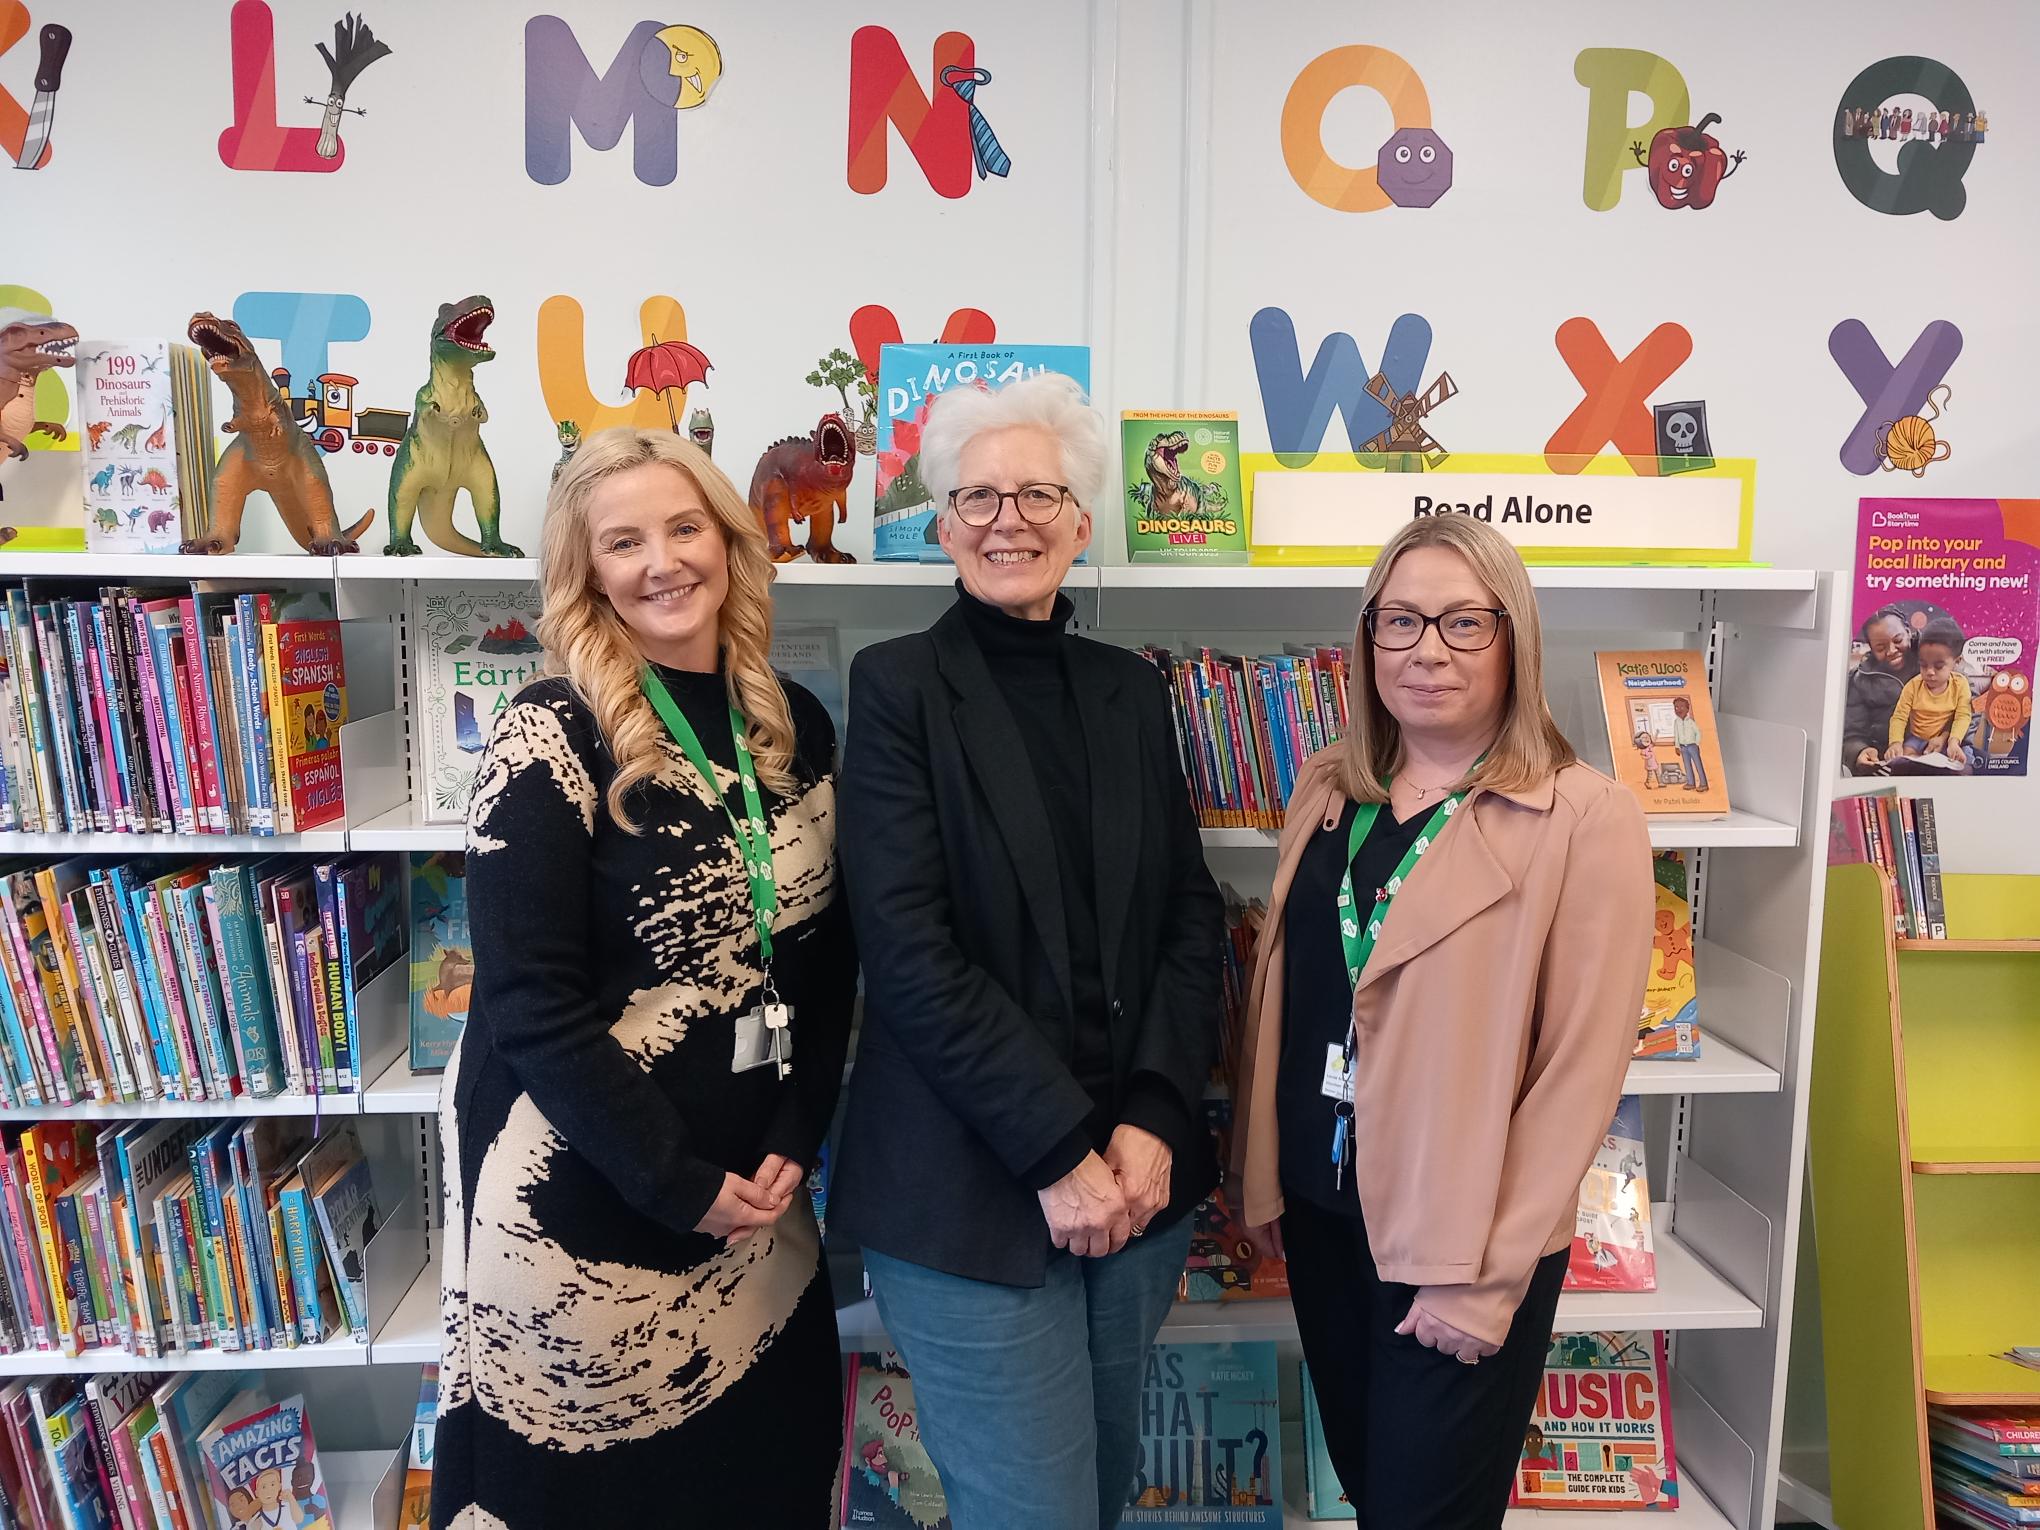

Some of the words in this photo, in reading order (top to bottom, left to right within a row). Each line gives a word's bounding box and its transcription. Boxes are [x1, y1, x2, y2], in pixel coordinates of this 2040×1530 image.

[218, 0, 346, 172] L
[525, 15, 678, 187] M
[847, 25, 974, 199] N
[1281, 45, 1431, 213] O
[1574, 47, 1690, 212] P
[1833, 56, 1976, 221] Q
[106, 356, 135, 375] 199
[538, 295, 688, 432] U
[96, 378, 151, 391] Dinosaurs
[888, 360, 1048, 417] DINOSAU
[1249, 307, 1432, 469] W
[1544, 317, 1693, 475] X
[1828, 319, 1963, 475] Y
[100, 396, 144, 406] Prehistoric
[107, 407, 142, 417] Animals
[1414, 495, 1493, 524] Read
[1501, 495, 1592, 524] Alone
[1887, 512, 1919, 520] BookTrust
[1137, 520, 1236, 535] DINOSAURS
[1887, 520, 1919, 528] Storytime
[1172, 534, 1204, 543] LIVE!
[1869, 535, 1903, 553] Pop
[1907, 536, 1940, 550] into
[1944, 538, 1982, 554] your
[1159, 548, 1173, 556] UK
[1174, 548, 1197, 556] TOUR
[1867, 554, 1909, 569] local
[1912, 554, 1969, 573] library
[1972, 555, 2006, 569] and
[1866, 574, 1892, 591] try
[1895, 573, 1986, 592] something
[1989, 574, 2028, 588] new!
[184, 615, 193, 635] 100
[294, 632, 310, 642] First
[311, 632, 325, 641] Words
[106, 625, 116, 654] CENTURY
[112, 655, 120, 680] fashion
[116, 687, 125, 699] The
[188, 637, 199, 670] Favourite
[246, 647, 255, 671] Ready
[292, 664, 334, 685] SPANISH
[1617, 663, 1649, 676] Katie
[1651, 661, 1688, 674] Woo's
[193, 672, 204, 703] Nursery
[250, 678, 259, 704] School
[1628, 679, 1682, 687] Neighbourhood
[198, 705, 208, 734] Rhymes
[253, 705, 262, 729] Words
[296, 752, 319, 766] Primeras
[304, 763, 340, 786] ESPAÑOL
[95, 887, 110, 929] EYEWITNESS
[110, 942, 120, 968] GUIDES
[341, 931, 347, 941] My
[1934, 925, 1944, 935] P
[117, 972, 129, 1001] INSECT
[230, 962, 261, 1023] Animals
[328, 960, 344, 1010] HUMAN
[219, 964, 226, 972] IN
[230, 1009, 239, 1032] Frogs
[332, 1011, 347, 1052] BODY!
[246, 1047, 265, 1062] DK
[1, 1163, 11, 1187] DANCE
[29, 1162, 40, 1191] WORLD
[135, 1160, 144, 1193] THE
[35, 1193, 43, 1204] OF
[38, 1204, 48, 1229] SPORT
[289, 1206, 300, 1243] HARRY
[74, 1268, 87, 1299] TERRIFIC
[80, 1300, 91, 1324] TEAMS
[1144, 1353, 1184, 1388] AS
[1211, 1370, 1230, 1382] KATIE
[1230, 1370, 1254, 1382] HICKEY
[871, 1385, 912, 1437] POOP
[1141, 1392, 1219, 1436] HAT
[90, 1401, 106, 1440] EYEWITNESS
[105, 1451, 117, 1477] GUIDES
[1544, 1421, 1566, 1432] AND
[1572, 1422, 1595, 1433] HOW
[1600, 1422, 1610, 1433] IT
[1616, 1423, 1654, 1434] WORKS
[220, 1435, 303, 1488] FACTS
[1568, 1474, 1582, 1482] THE
[1584, 1474, 1624, 1483] COMPLETE
[1568, 1485, 1590, 1493] GUIDE
[1592, 1485, 1607, 1493] FOR
[1609, 1485, 1625, 1493] KIDS
[112, 1478, 124, 1509] VIKING
[1136, 1512, 1162, 1522] STORIES
[1165, 1512, 1189, 1522] BEHIND
[1191, 1512, 1221, 1522] AWESOME
[1224, 1512, 1266, 1522] STRUCTURES
